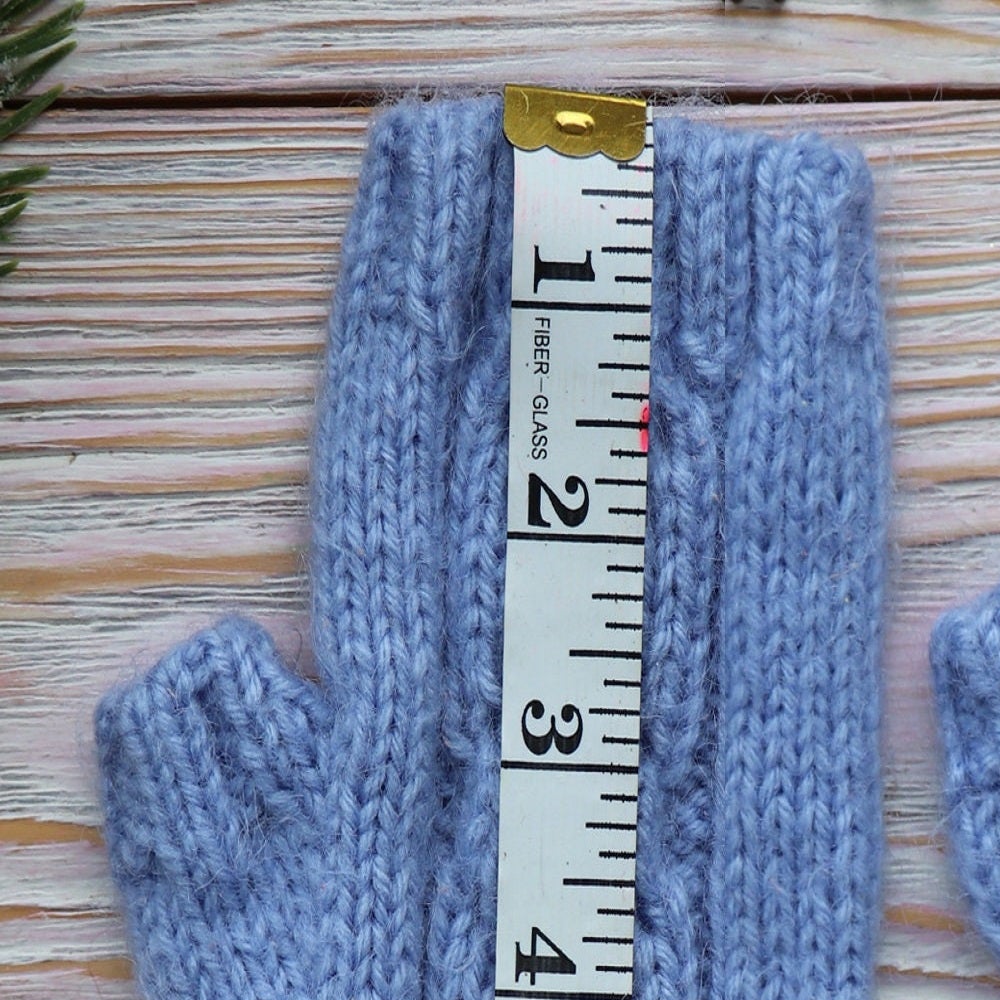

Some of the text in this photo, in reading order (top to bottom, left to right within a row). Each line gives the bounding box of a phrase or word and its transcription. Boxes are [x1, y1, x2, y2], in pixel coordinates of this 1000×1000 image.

[533, 244, 596, 294] 1
[527, 472, 588, 528] 2
[521, 699, 584, 756] 3
[514, 926, 577, 985] 4
